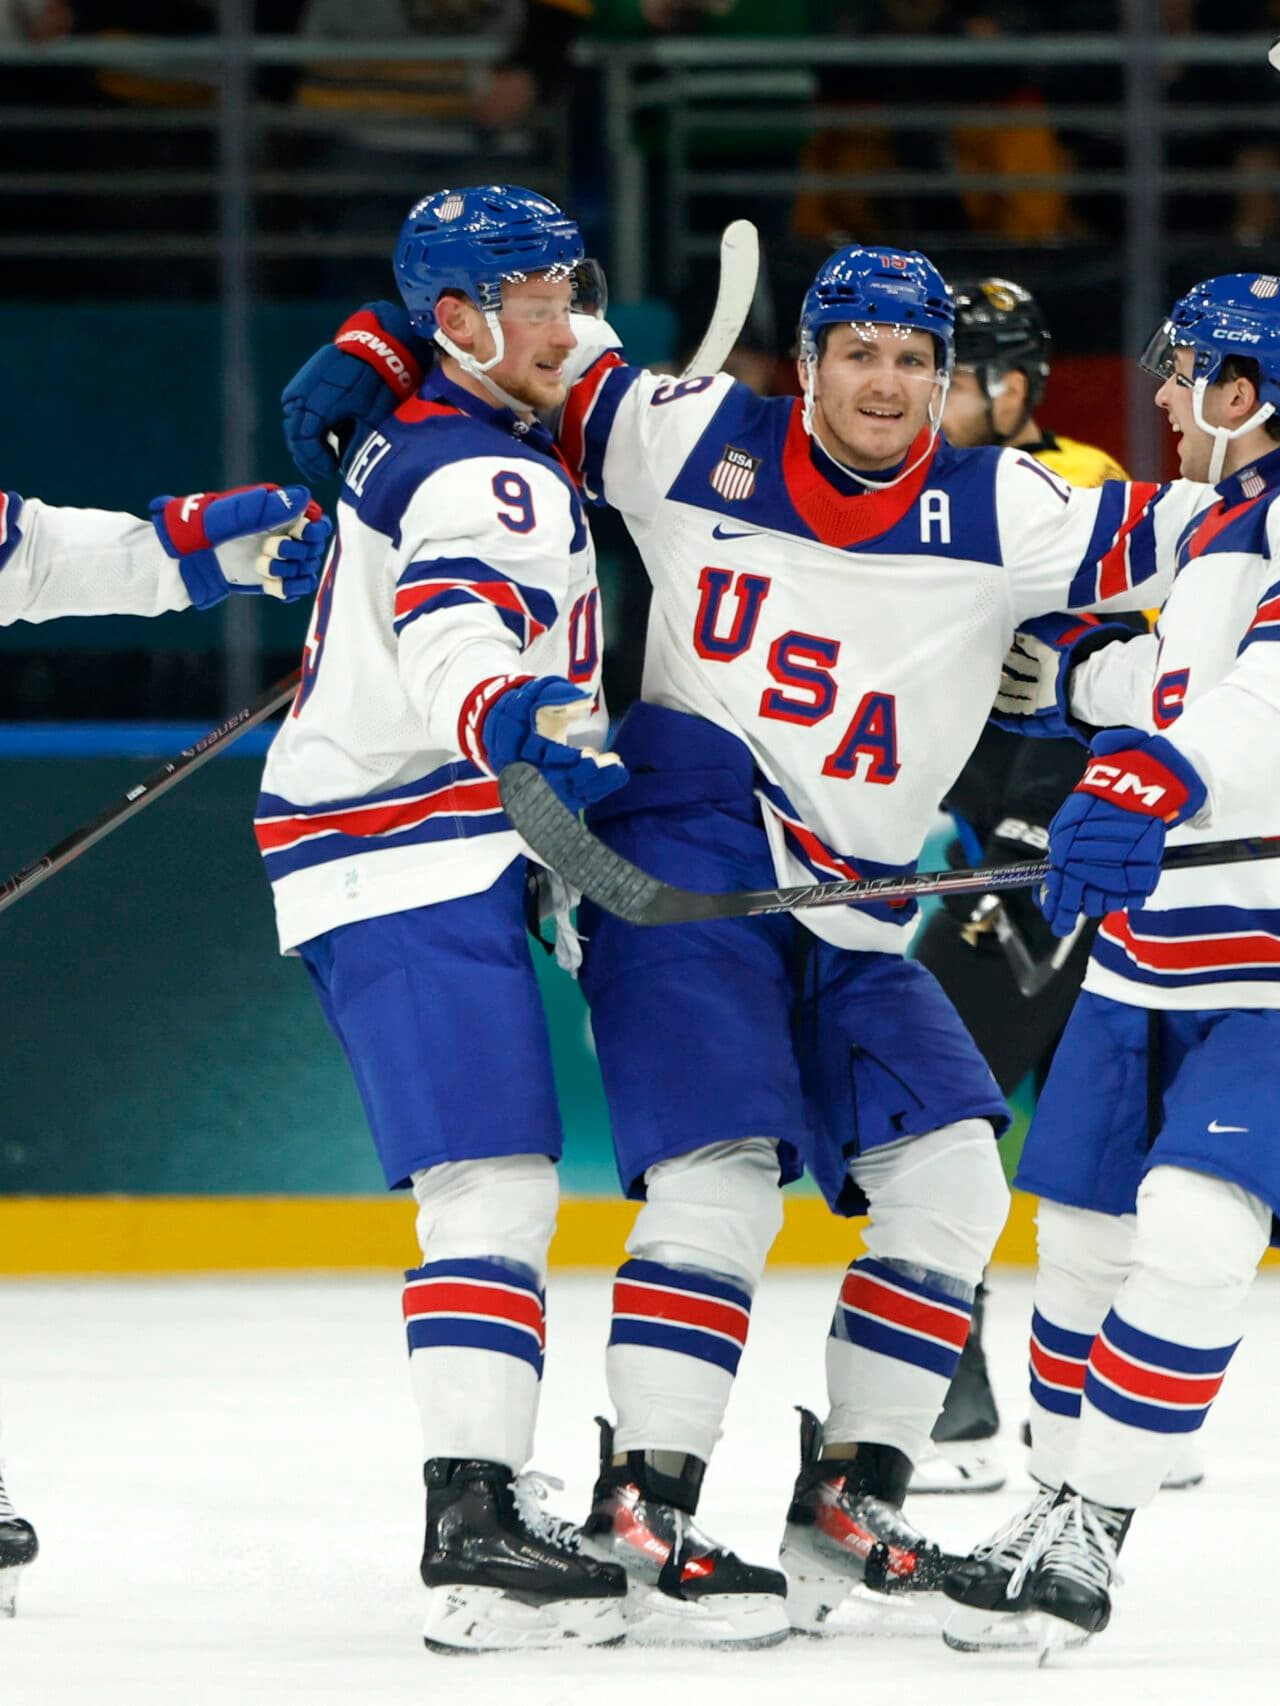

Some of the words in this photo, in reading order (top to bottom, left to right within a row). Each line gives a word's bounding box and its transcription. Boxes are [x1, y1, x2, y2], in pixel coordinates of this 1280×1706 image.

[1212, 328, 1262, 345] CCM
[727, 450, 754, 470] USA
[491, 470, 536, 534] 9
[920, 489, 951, 544] A
[693, 566, 901, 785] USA
[196, 708, 250, 754] BAUER
[1080, 764, 1167, 807] CM
